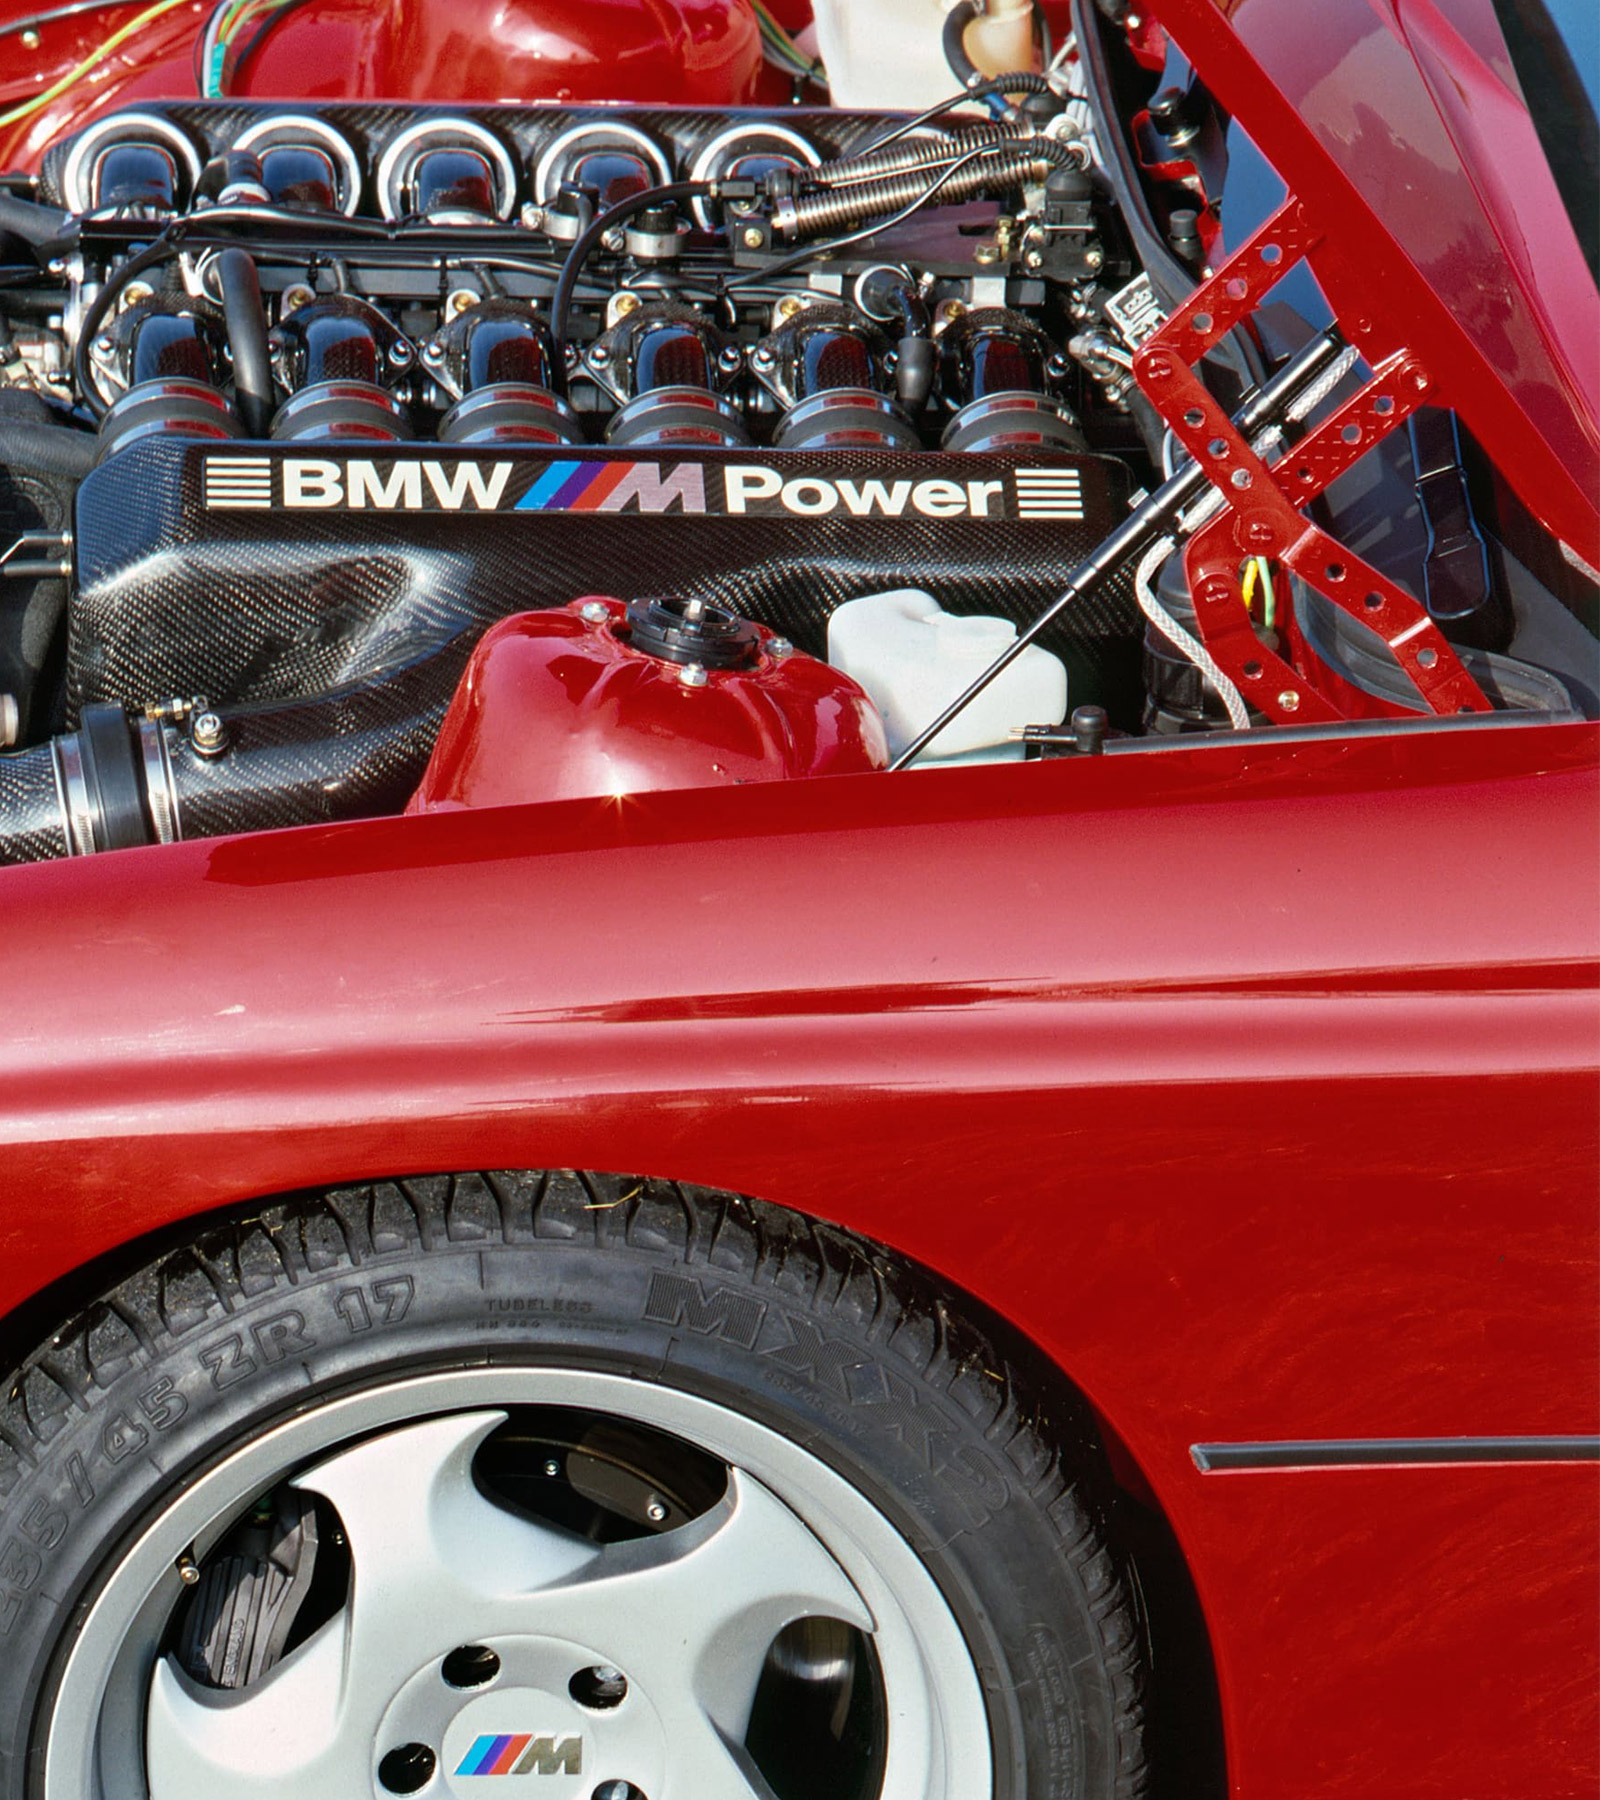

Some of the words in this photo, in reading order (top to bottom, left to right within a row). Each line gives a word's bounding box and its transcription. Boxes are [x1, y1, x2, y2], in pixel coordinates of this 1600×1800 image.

[281, 459, 514, 511] BMW
[600, 461, 706, 513] M
[724, 465, 1003, 518] Power
[487, 1298, 594, 1314] TUBELESS
[198, 1309, 317, 1393] ZR
[334, 1273, 416, 1334] 17
[511, 1737, 583, 1775] M
